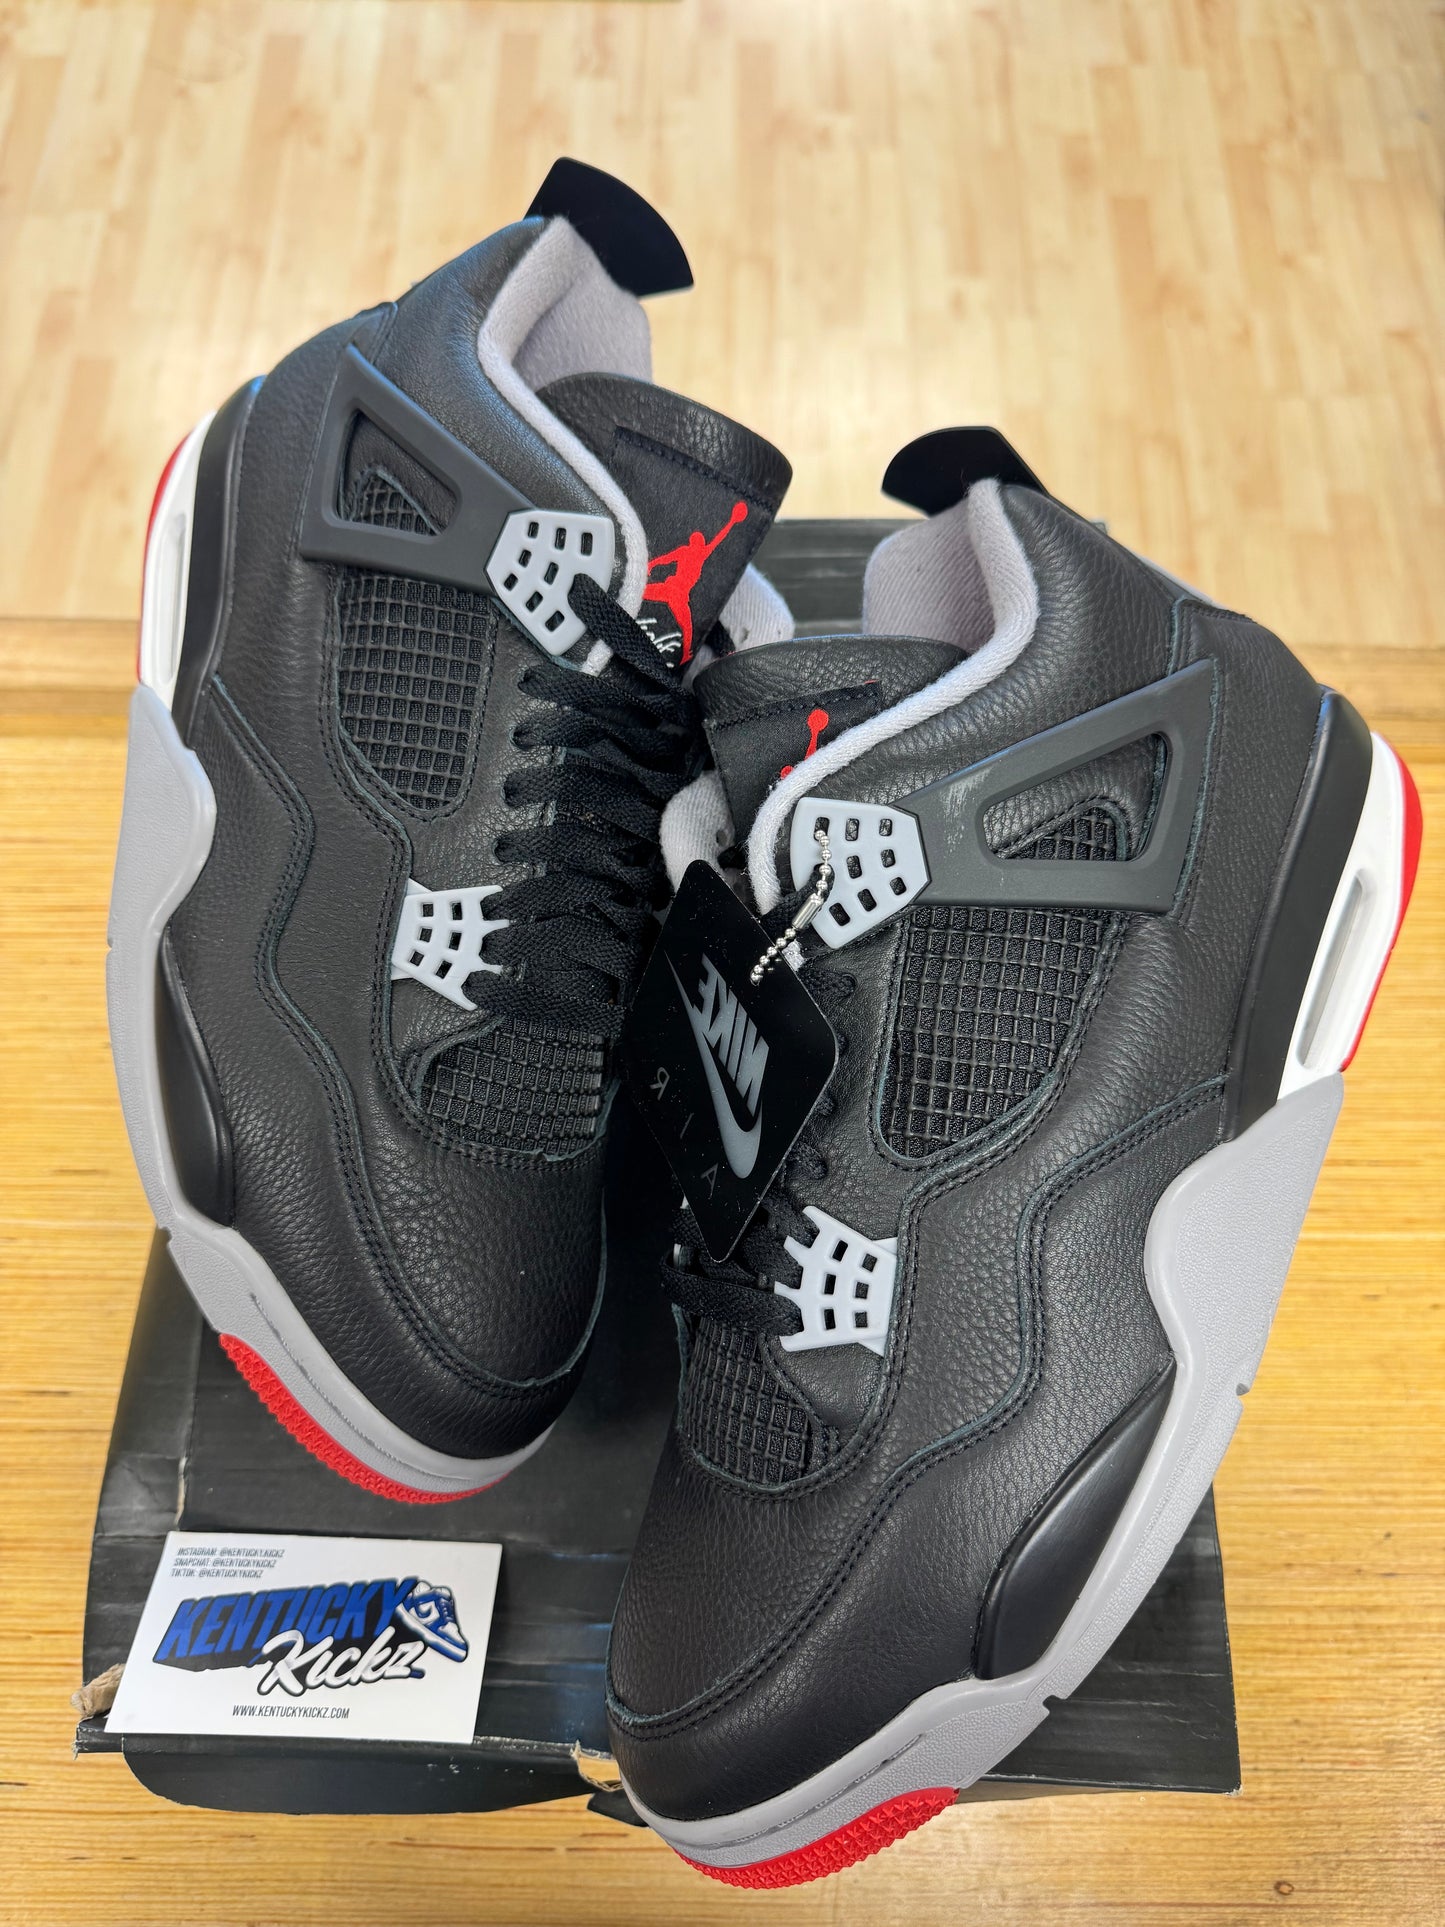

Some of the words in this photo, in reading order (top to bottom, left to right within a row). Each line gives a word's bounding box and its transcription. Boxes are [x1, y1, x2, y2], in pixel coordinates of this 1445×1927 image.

[173, 1557, 210, 1567] SNAPCHAT:
[212, 1558, 277, 1568] @KENTUCKYKICKZ
[171, 1568, 196, 1577] TIKTOK:
[198, 1568, 264, 1578] @KENTUCKYKICKZ
[155, 1577, 418, 1664] KENTUCKY
[258, 1626, 425, 1696] Kickz
[232, 1704, 350, 1719] WWW.KENTUCKYKICKZ.COM
